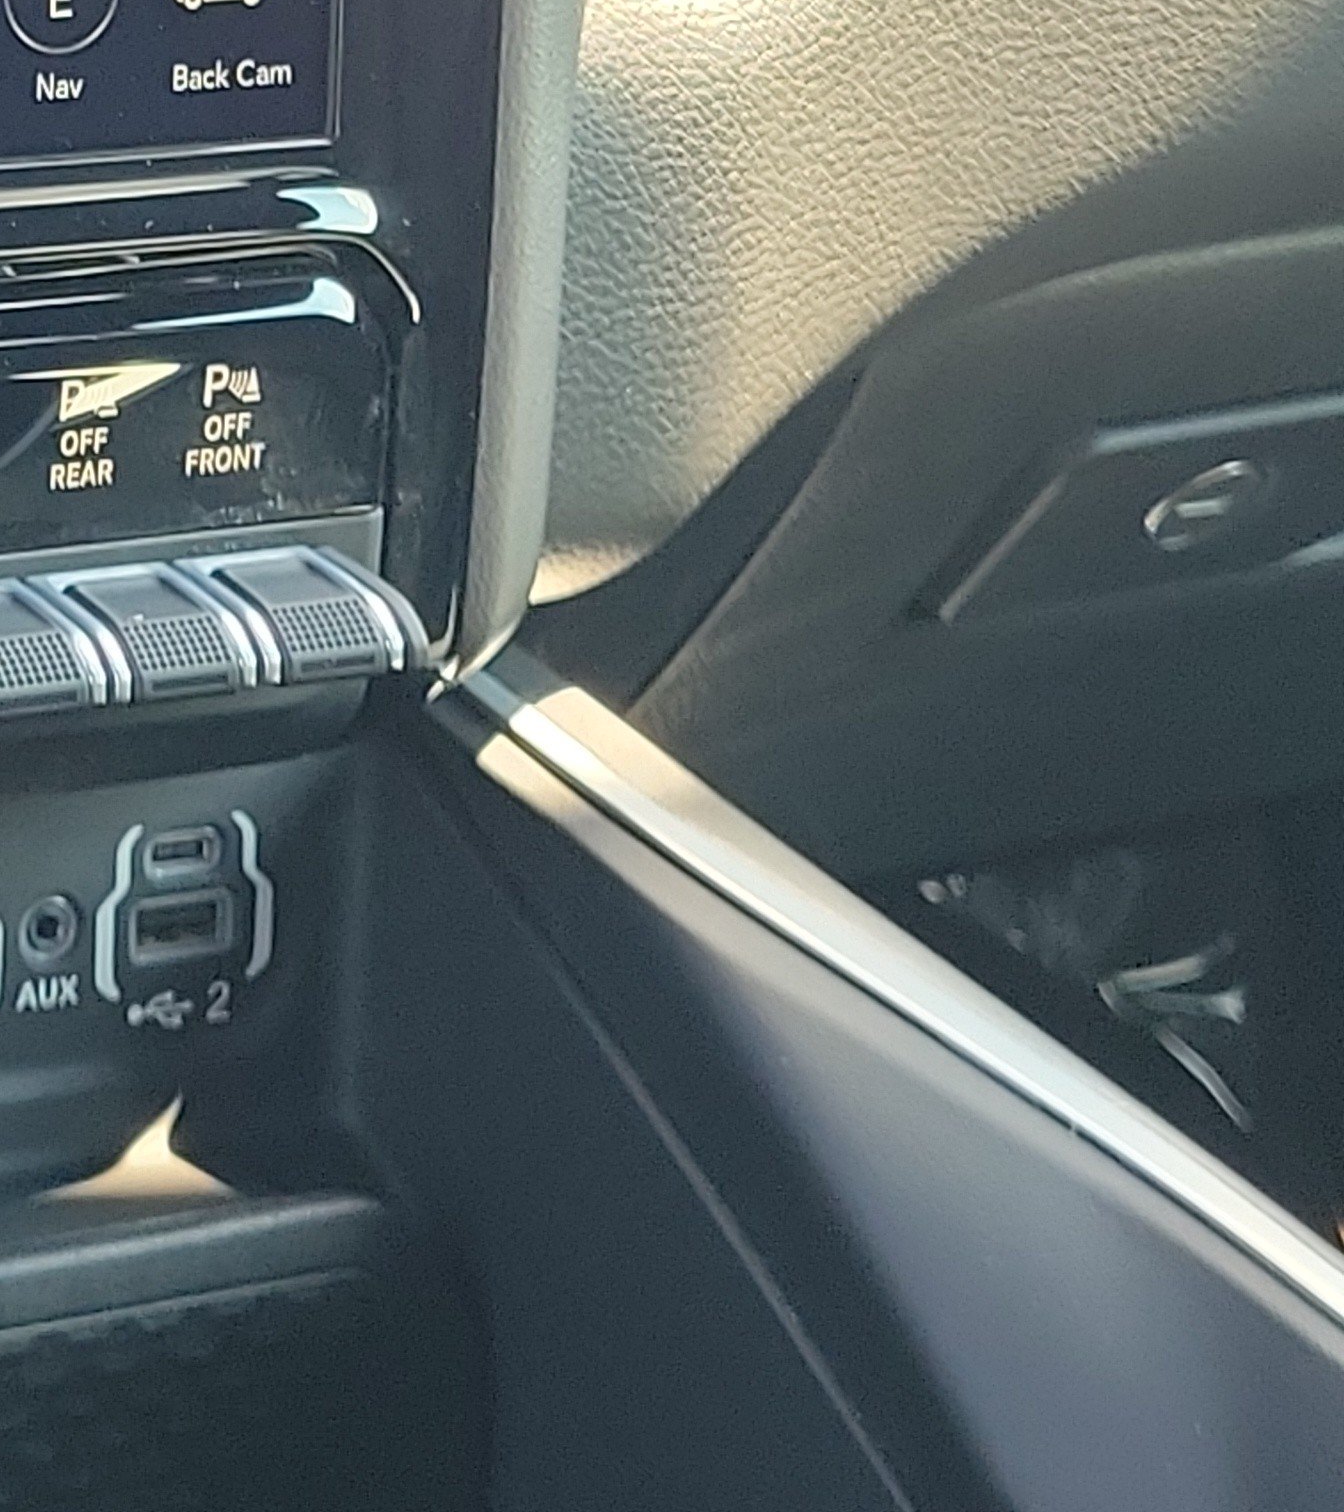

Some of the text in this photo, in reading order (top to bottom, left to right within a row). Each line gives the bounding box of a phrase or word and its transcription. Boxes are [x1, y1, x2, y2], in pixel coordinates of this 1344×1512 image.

[34, 73, 84, 102] Nav
[172, 59, 293, 92] Back Cam
[59, 427, 109, 458] OFF
[204, 412, 252, 444] OFF
[49, 457, 114, 491] REAR
[184, 442, 266, 477] FRONT
[14, 973, 81, 1014] AUX
[206, 981, 232, 1025] 2
